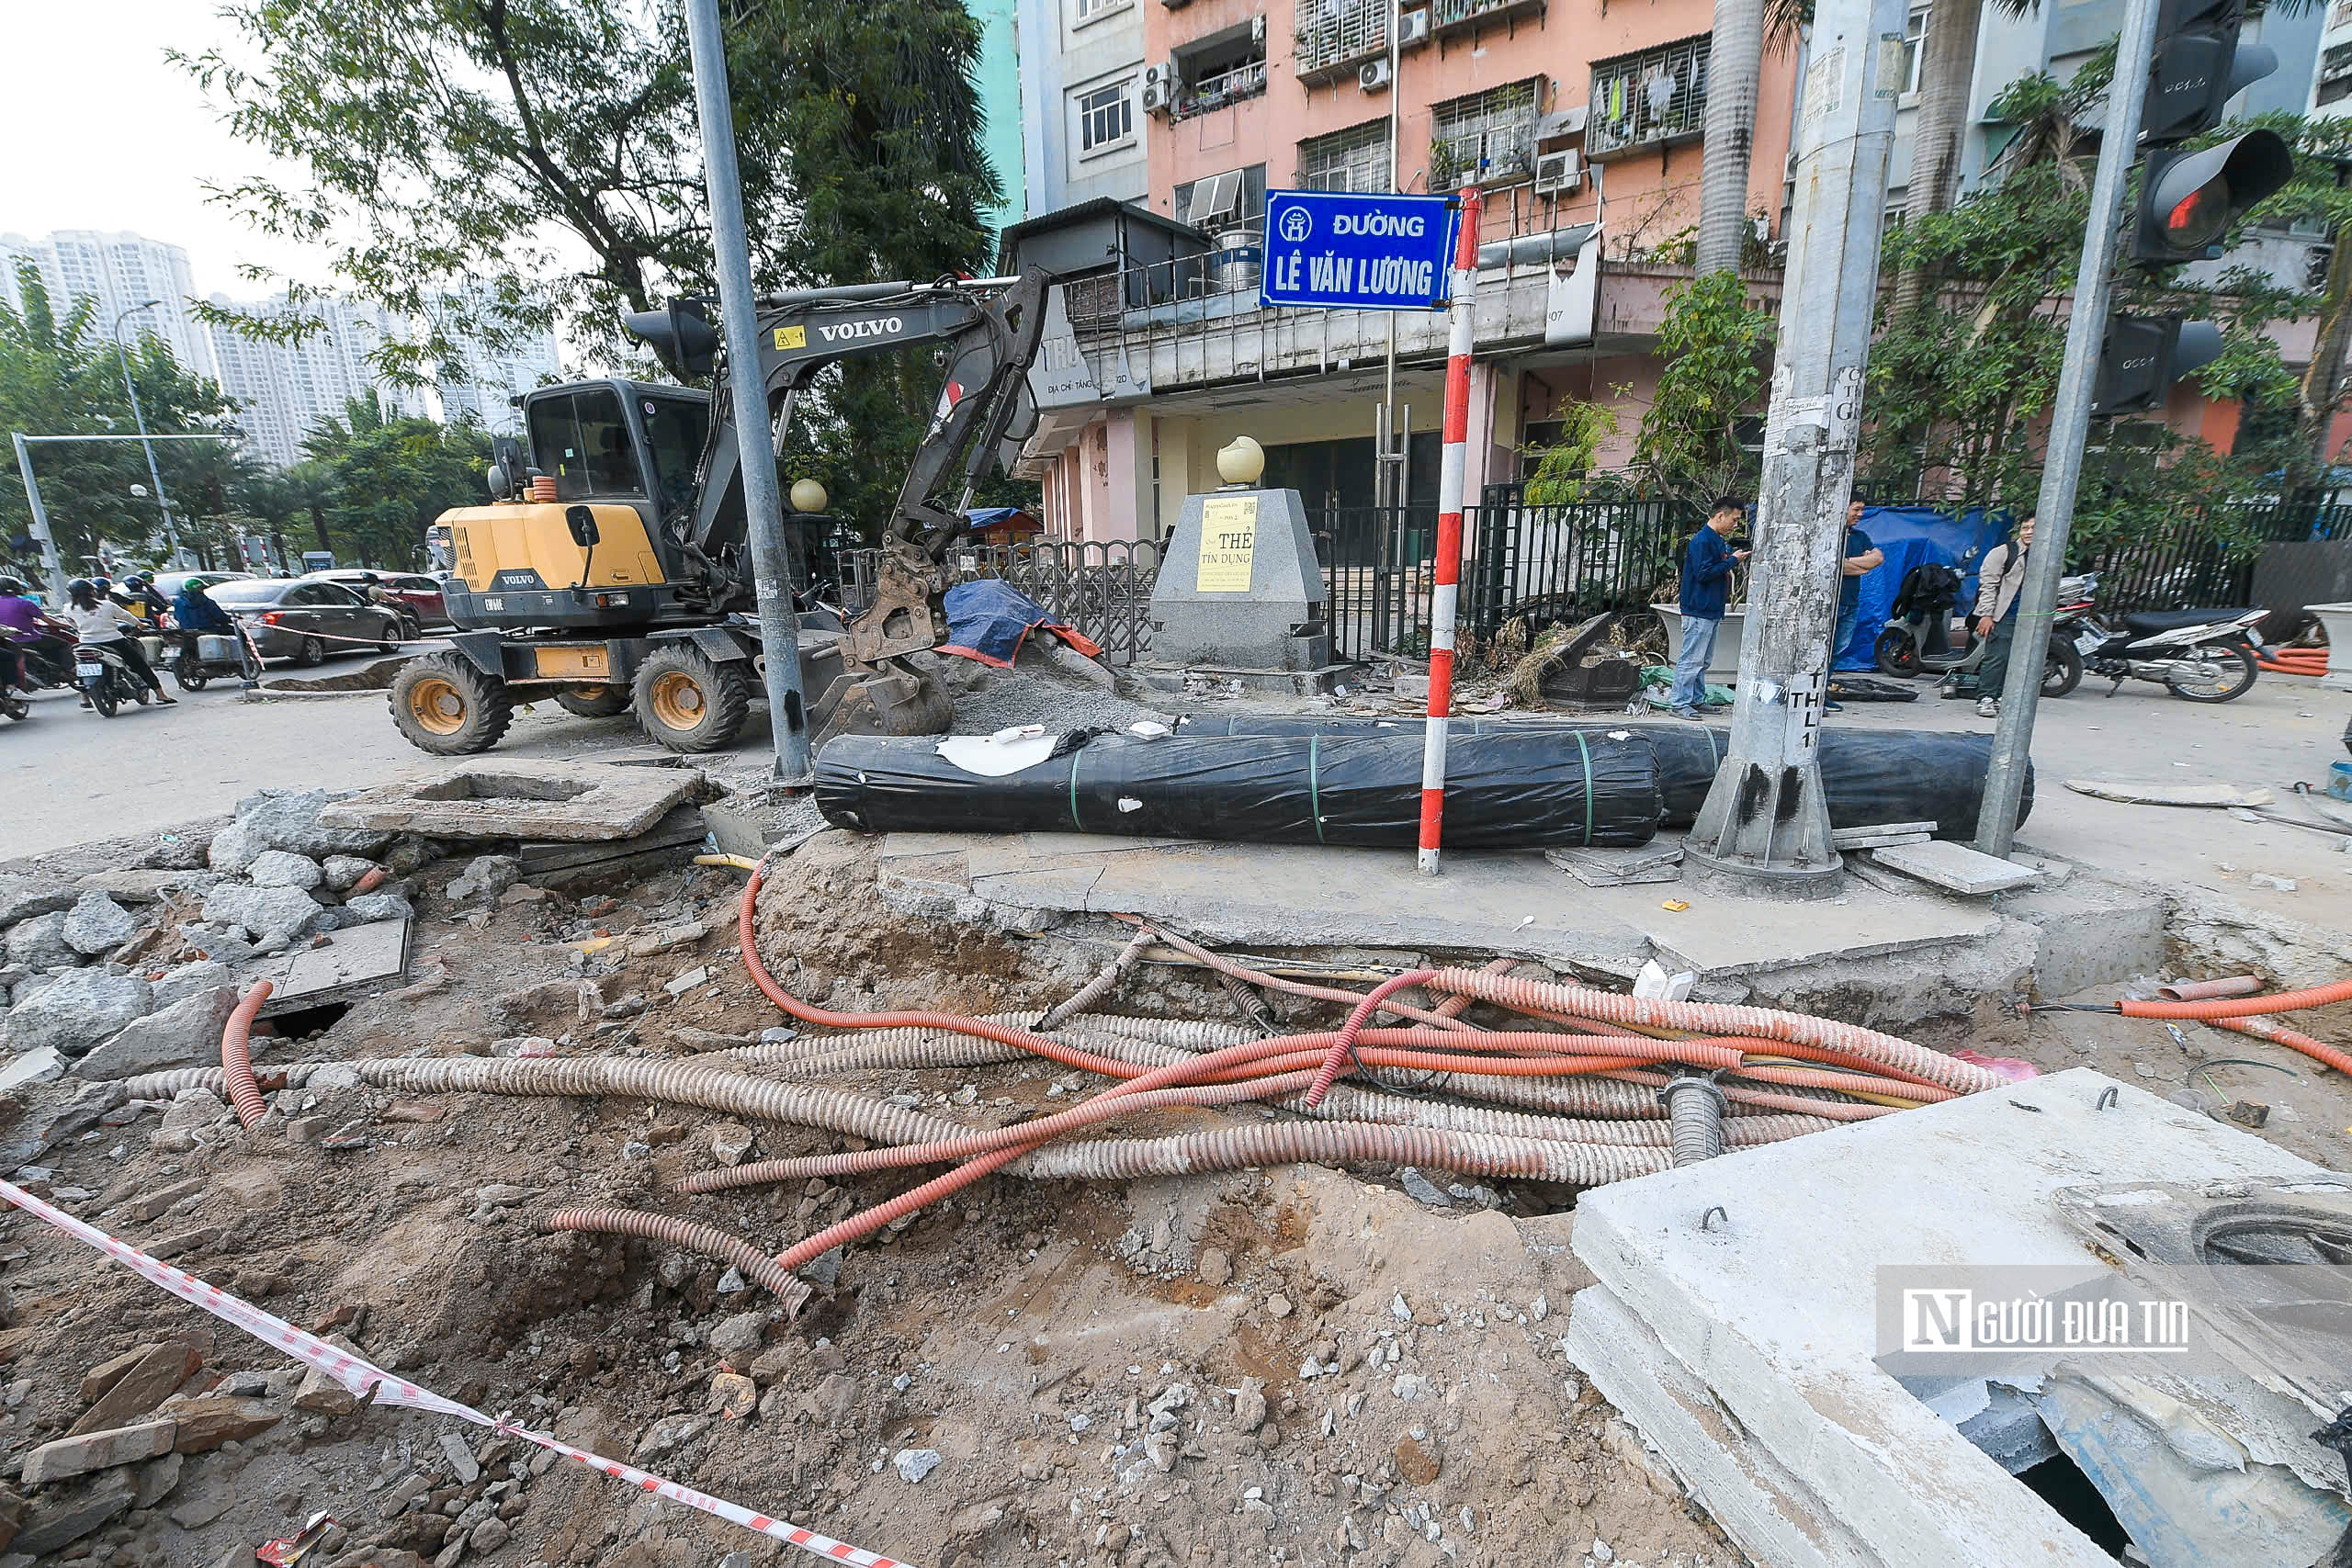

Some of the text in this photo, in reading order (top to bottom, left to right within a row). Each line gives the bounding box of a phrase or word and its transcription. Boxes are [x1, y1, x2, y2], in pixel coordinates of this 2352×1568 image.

[1333, 209, 1424, 237] ĐƯỜNG
[1275, 249, 1433, 295] LÊ VĂN LƯƠNG
[818, 316, 903, 342] VOLVO
[1218, 526, 1252, 549] THẺ
[1201, 552, 1250, 566] TÍN DỤNG
[502, 574, 535, 586] VOLVO
